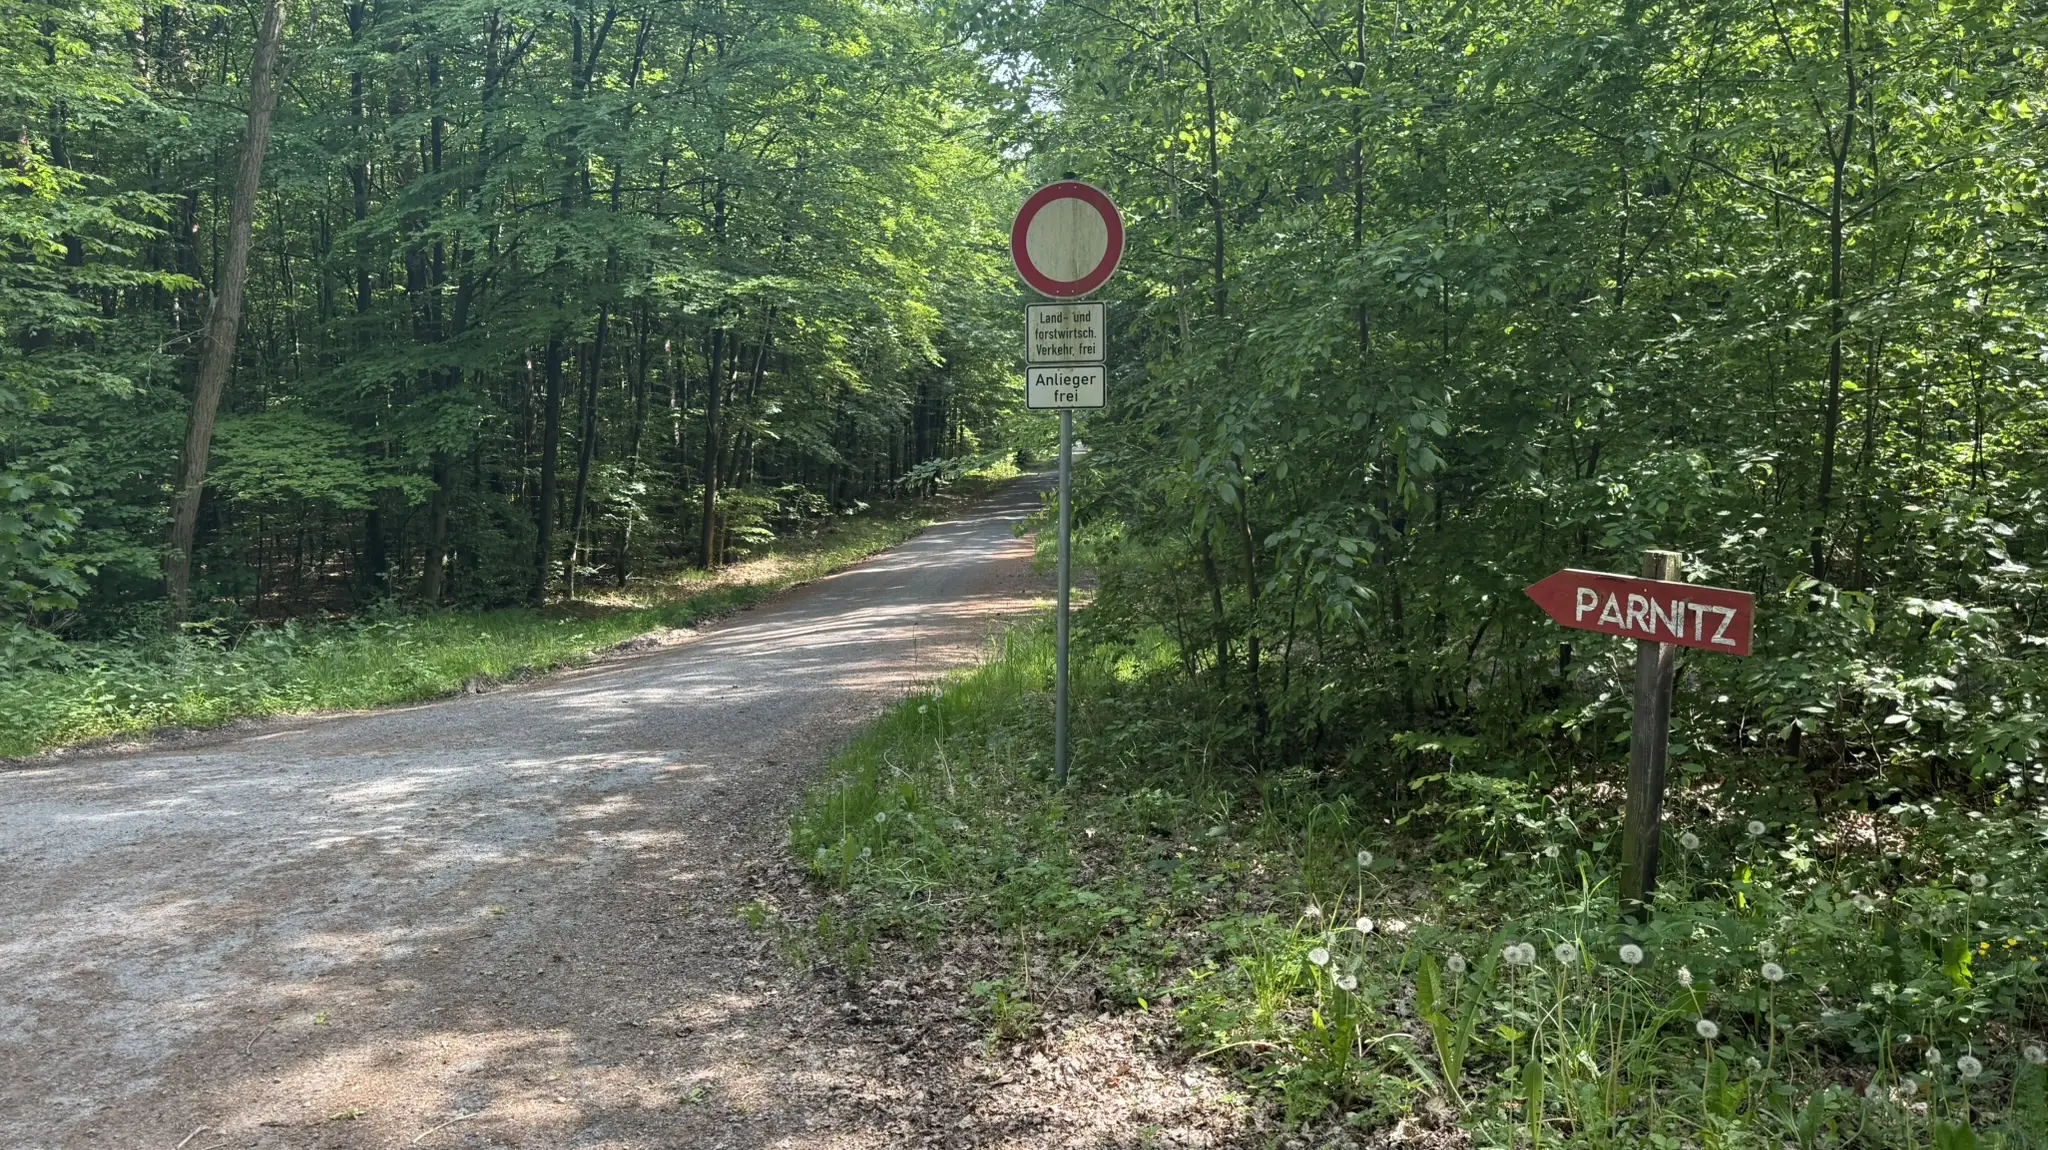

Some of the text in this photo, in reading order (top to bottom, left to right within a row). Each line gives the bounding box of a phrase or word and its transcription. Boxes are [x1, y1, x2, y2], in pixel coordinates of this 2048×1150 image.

[1040, 311, 1091, 324] Land- und
[1035, 327, 1096, 340] forstwirtsch.
[1079, 343, 1096, 355] frei
[1035, 373, 1096, 388] Anlieger
[1054, 389, 1078, 402] frei
[1575, 587, 1737, 647] PARNITZ
